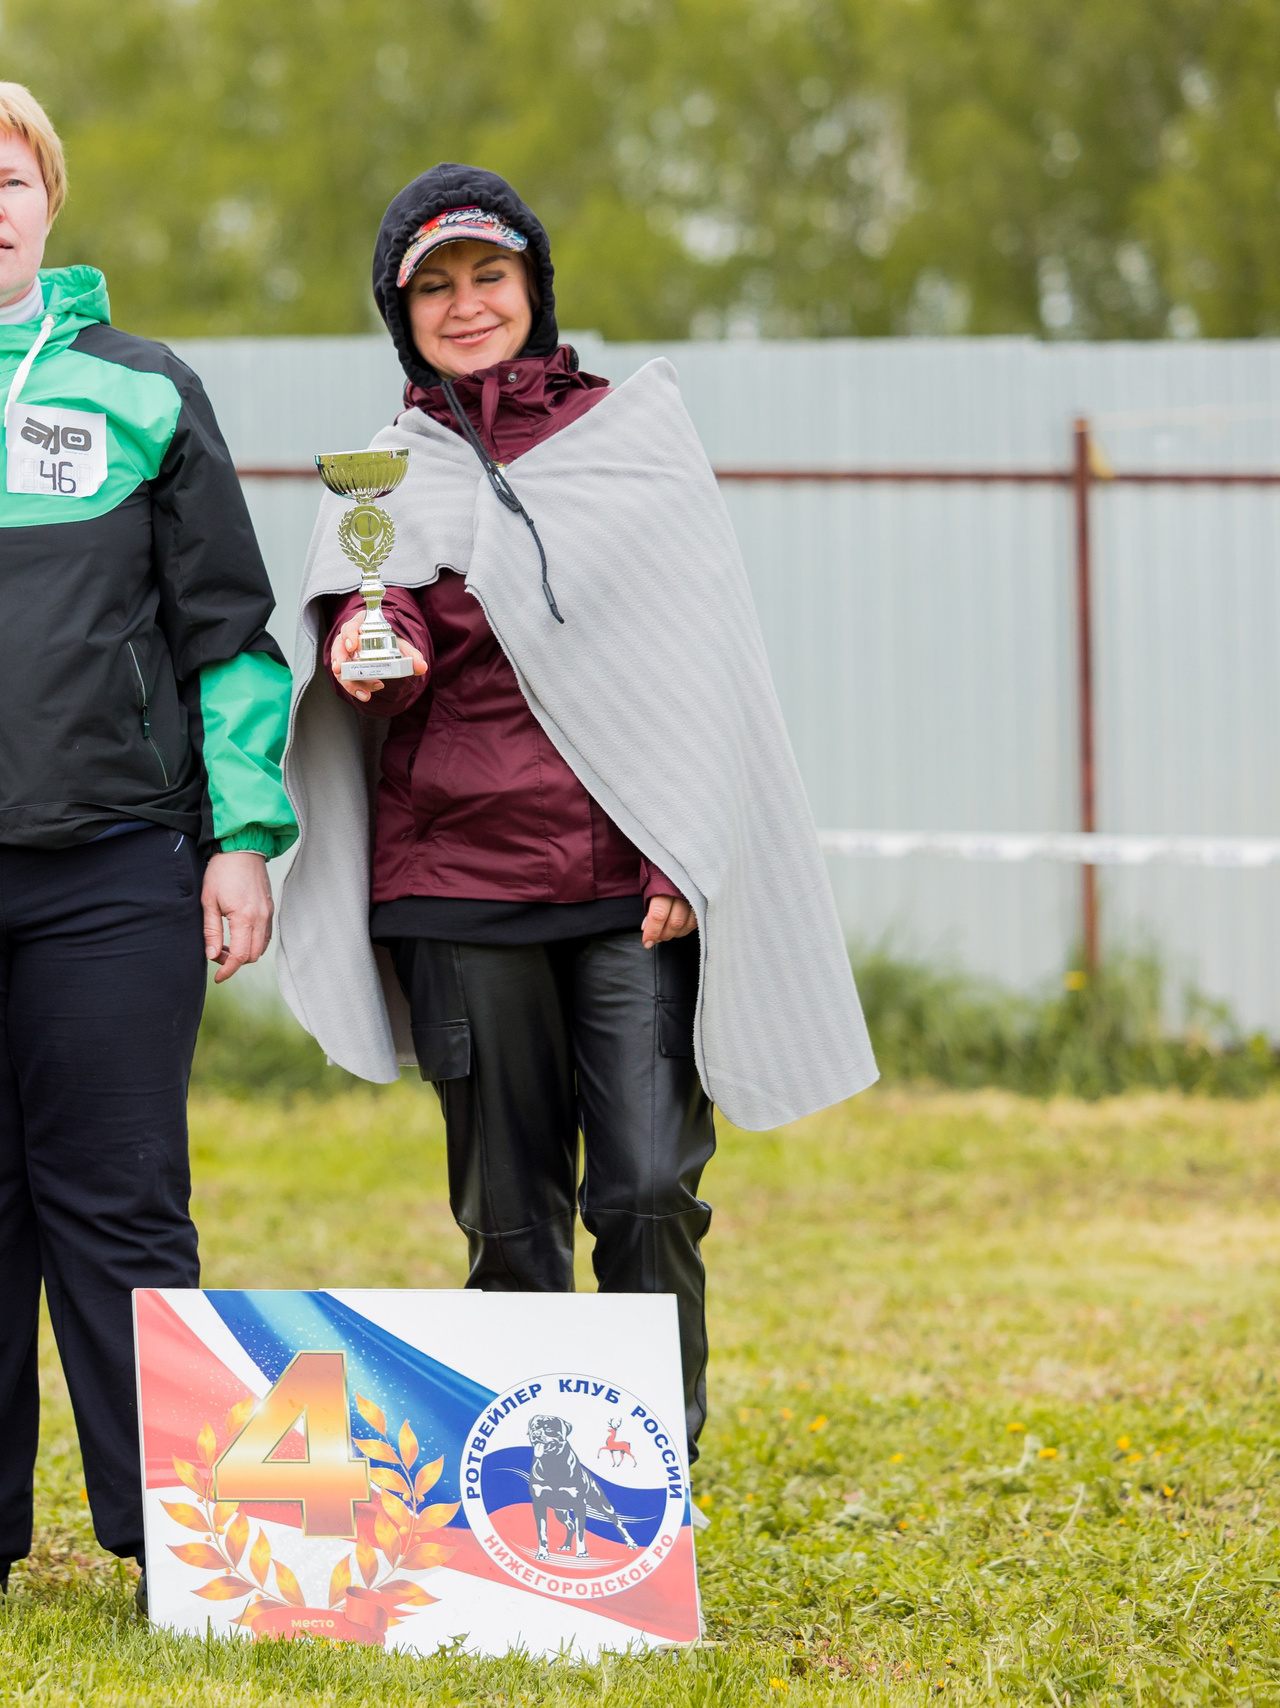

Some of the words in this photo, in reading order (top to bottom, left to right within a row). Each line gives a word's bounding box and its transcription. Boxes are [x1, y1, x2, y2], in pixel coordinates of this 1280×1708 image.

[40, 461, 76, 493] 46
[213, 1351, 372, 1539] 4
[466, 1383, 542, 1500] РОТВЕЙЛЕР
[558, 1378, 621, 1405] КЛУБ
[631, 1405, 683, 1500] РОССИИ
[483, 1534, 654, 1598] НИЖЕГОРОДСКОЕ
[653, 1533, 674, 1561] РО
[291, 1619, 335, 1628] место
